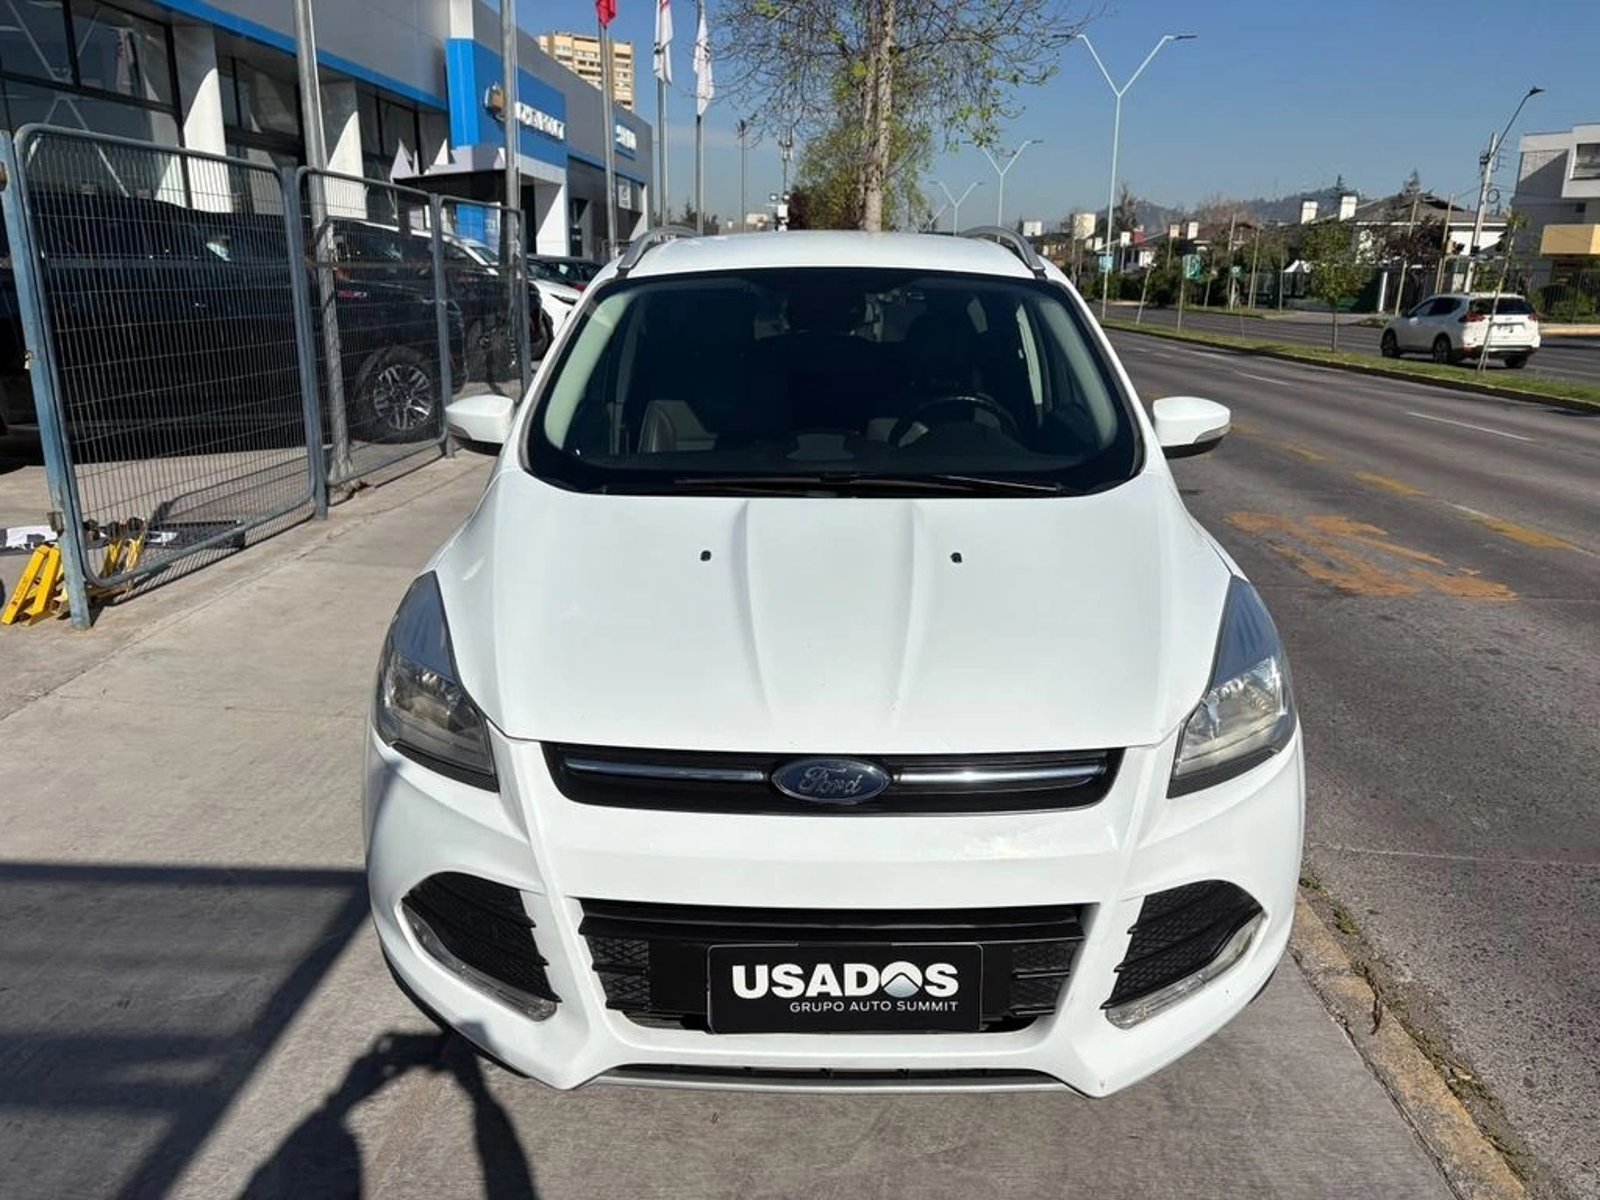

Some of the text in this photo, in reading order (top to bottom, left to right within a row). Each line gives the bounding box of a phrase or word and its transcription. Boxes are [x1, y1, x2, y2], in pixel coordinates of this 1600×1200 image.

[799, 766, 863, 795] Ford
[732, 960, 959, 999] USADOS
[789, 1000, 958, 1013] GRUPO AUTO SUMMIT
